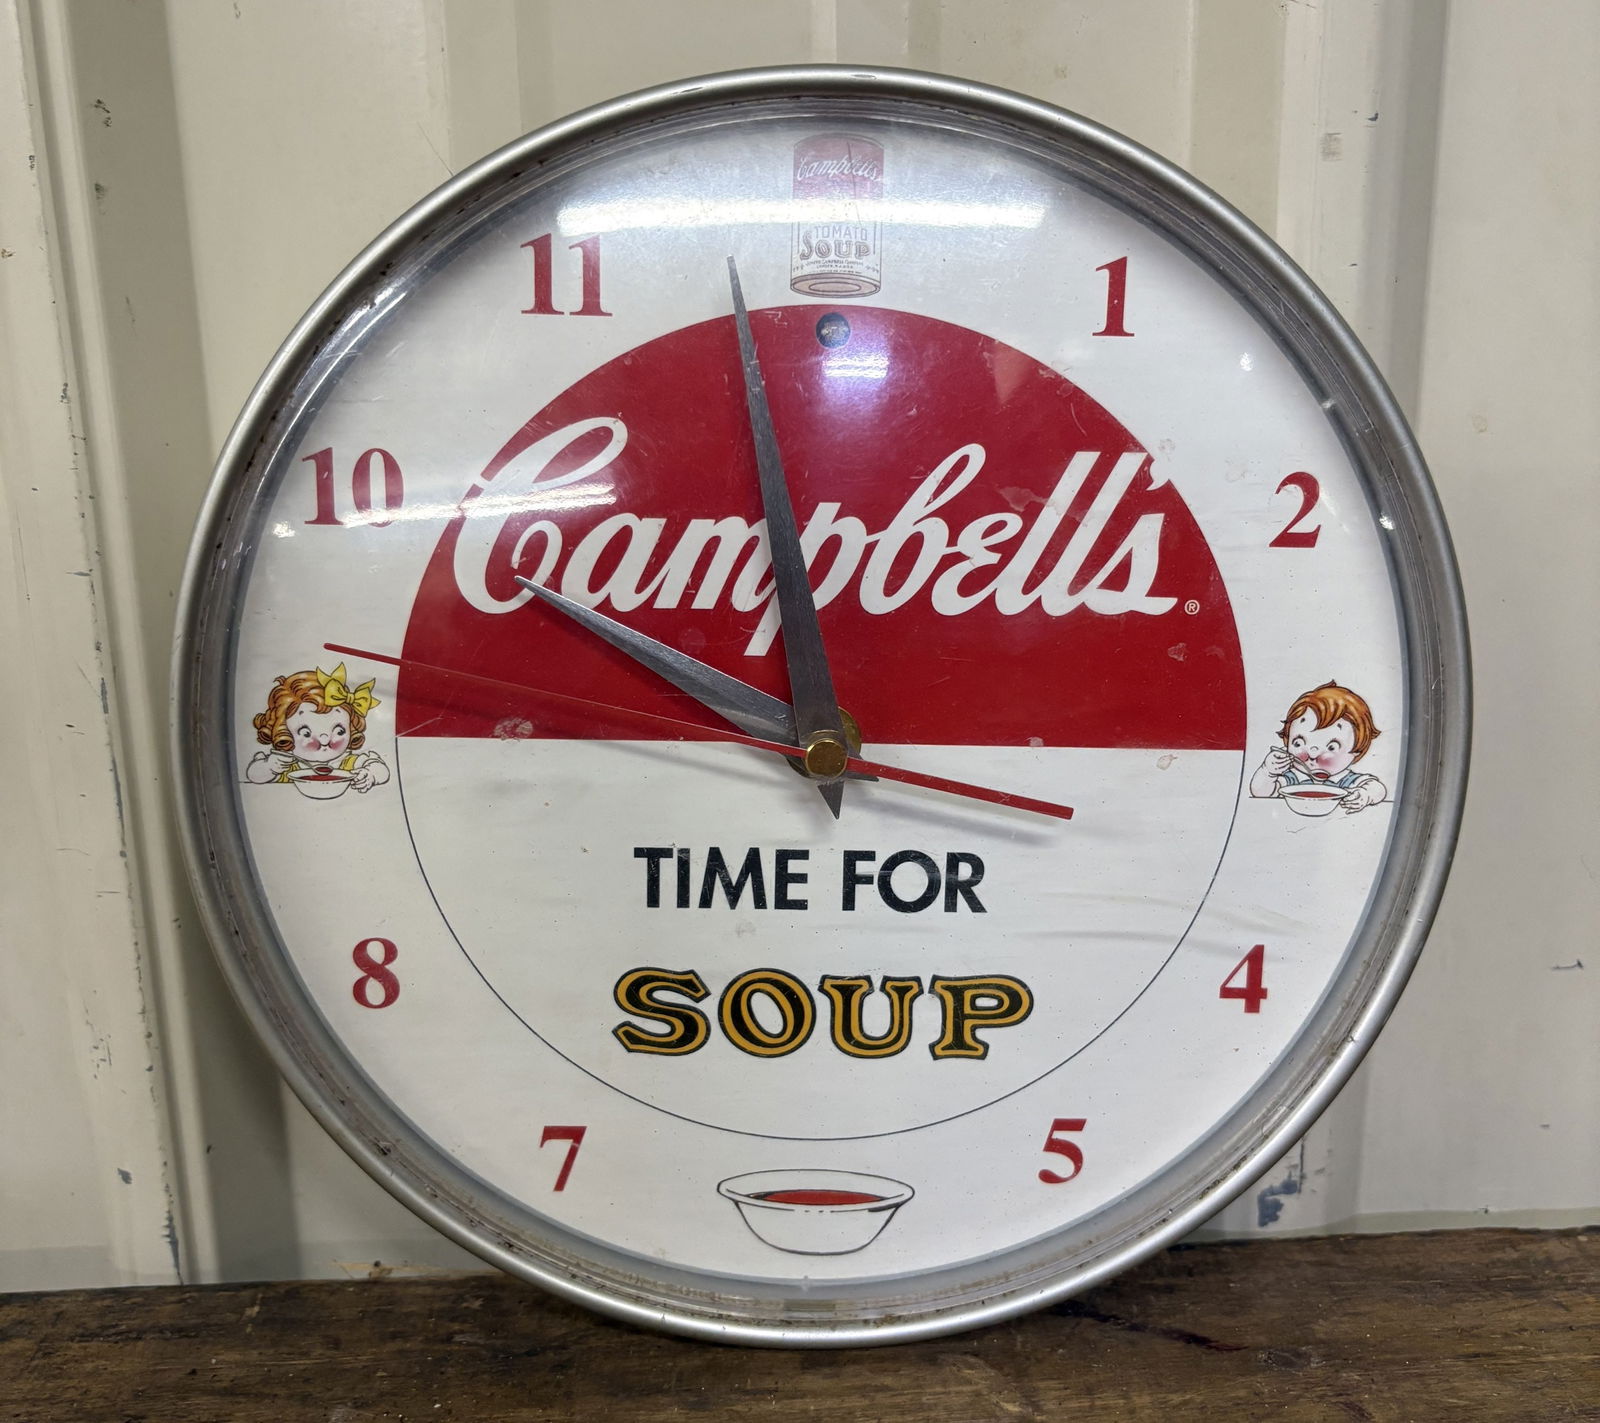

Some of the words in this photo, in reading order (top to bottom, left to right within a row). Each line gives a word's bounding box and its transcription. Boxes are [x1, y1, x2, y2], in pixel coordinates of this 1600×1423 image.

[800, 231, 870, 260] SOUP
[814, 226, 868, 241] TOMATO
[520, 233, 613, 317] 11
[1092, 256, 1134, 337] 1
[301, 447, 405, 528] 10
[1269, 472, 1321, 548] 2
[634, 847, 809, 910] TIME
[842, 850, 987, 913] FOR
[352, 937, 400, 1009] 8
[1219, 945, 1268, 1013] 4
[611, 966, 1034, 1061] SOUP
[539, 1126, 587, 1192] 7
[1038, 1118, 1087, 1184] 5
